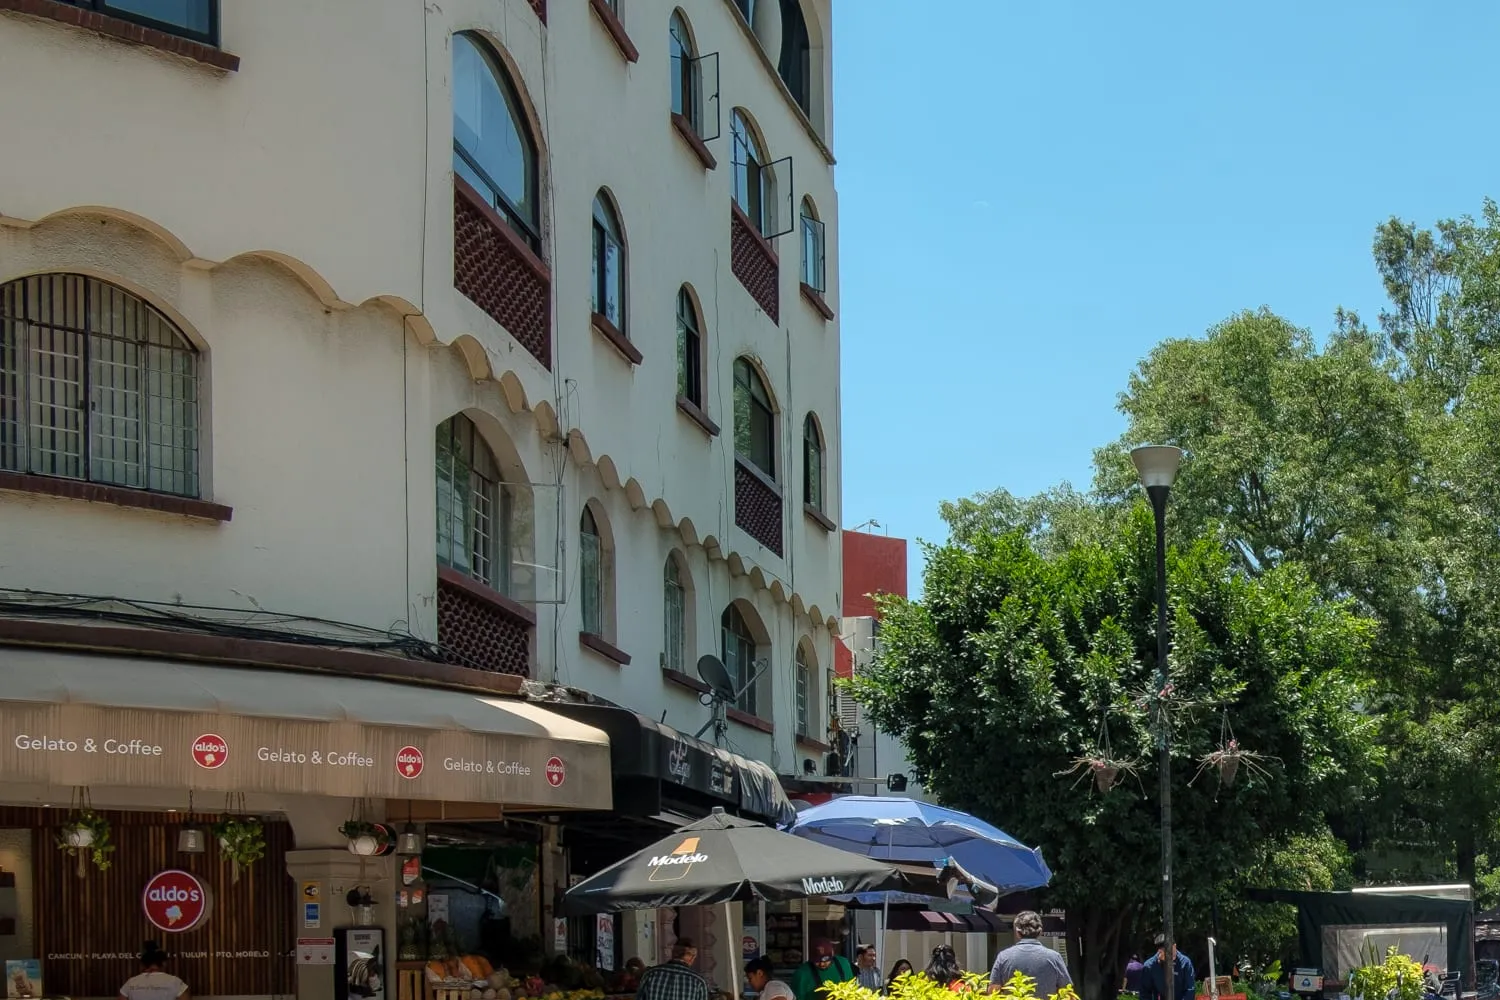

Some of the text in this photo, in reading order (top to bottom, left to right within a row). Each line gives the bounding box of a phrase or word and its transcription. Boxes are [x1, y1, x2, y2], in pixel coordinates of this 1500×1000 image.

[15, 734, 163, 756] Gelato & Coffee
[194, 743, 226, 753] aldo's
[257, 747, 374, 767] Gelato & Coffee
[443, 757, 531, 776] Gelato & Coffee
[647, 853, 708, 867] Modelo
[149, 886, 200, 902] aldo's
[802, 875, 844, 896] Modelo
[91, 952, 117, 960] PLAYA
